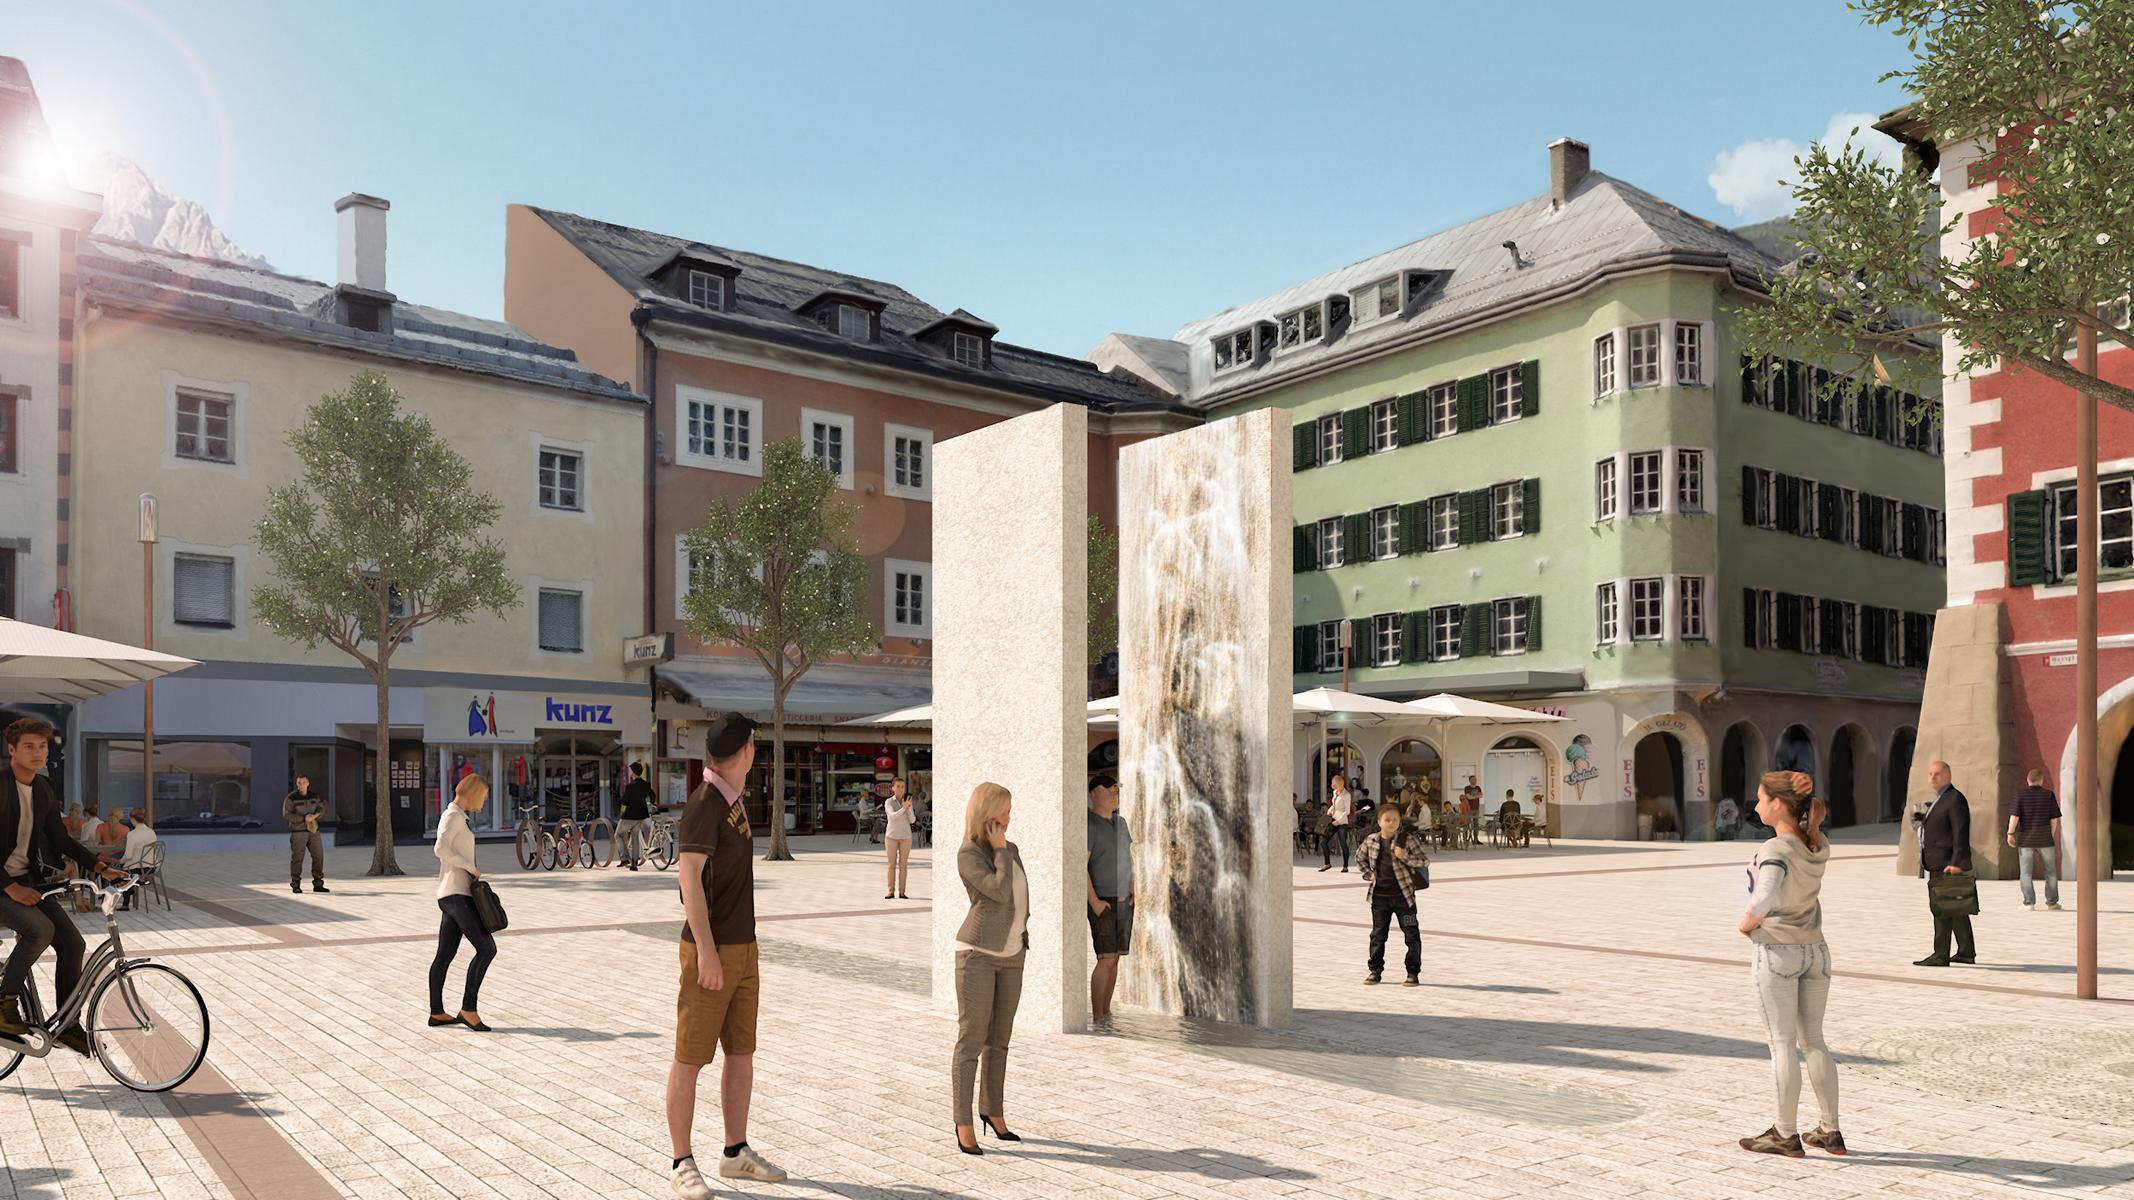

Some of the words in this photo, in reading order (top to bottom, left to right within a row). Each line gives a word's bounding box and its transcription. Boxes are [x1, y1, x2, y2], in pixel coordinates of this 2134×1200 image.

[633, 644, 657, 658] kunz
[545, 697, 613, 724] kunz
[1623, 760, 1633, 798] EIS
[1696, 759, 1705, 798] EIS
